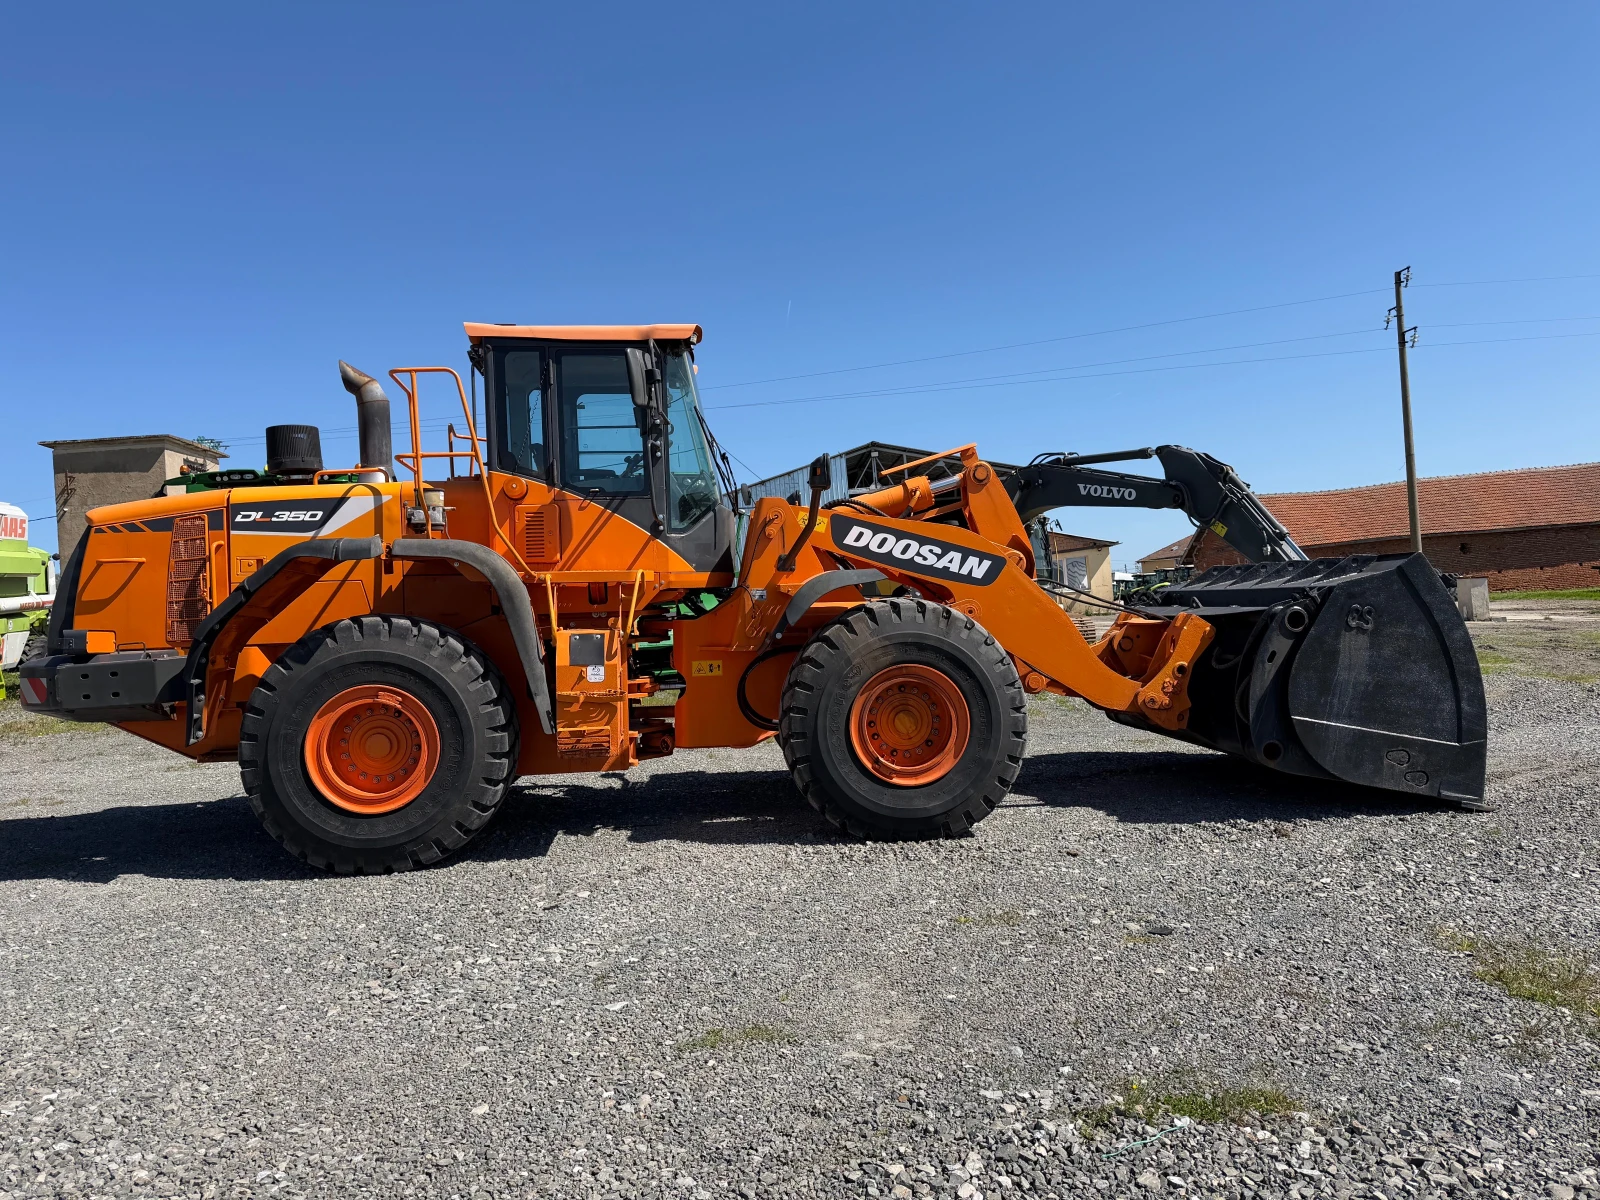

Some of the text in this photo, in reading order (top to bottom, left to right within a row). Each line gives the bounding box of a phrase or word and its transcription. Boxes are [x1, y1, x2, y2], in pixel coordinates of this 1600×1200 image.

[1077, 484, 1136, 500] VOLVO
[235, 511, 323, 522] DL350
[843, 525, 992, 579] DOOSAN
